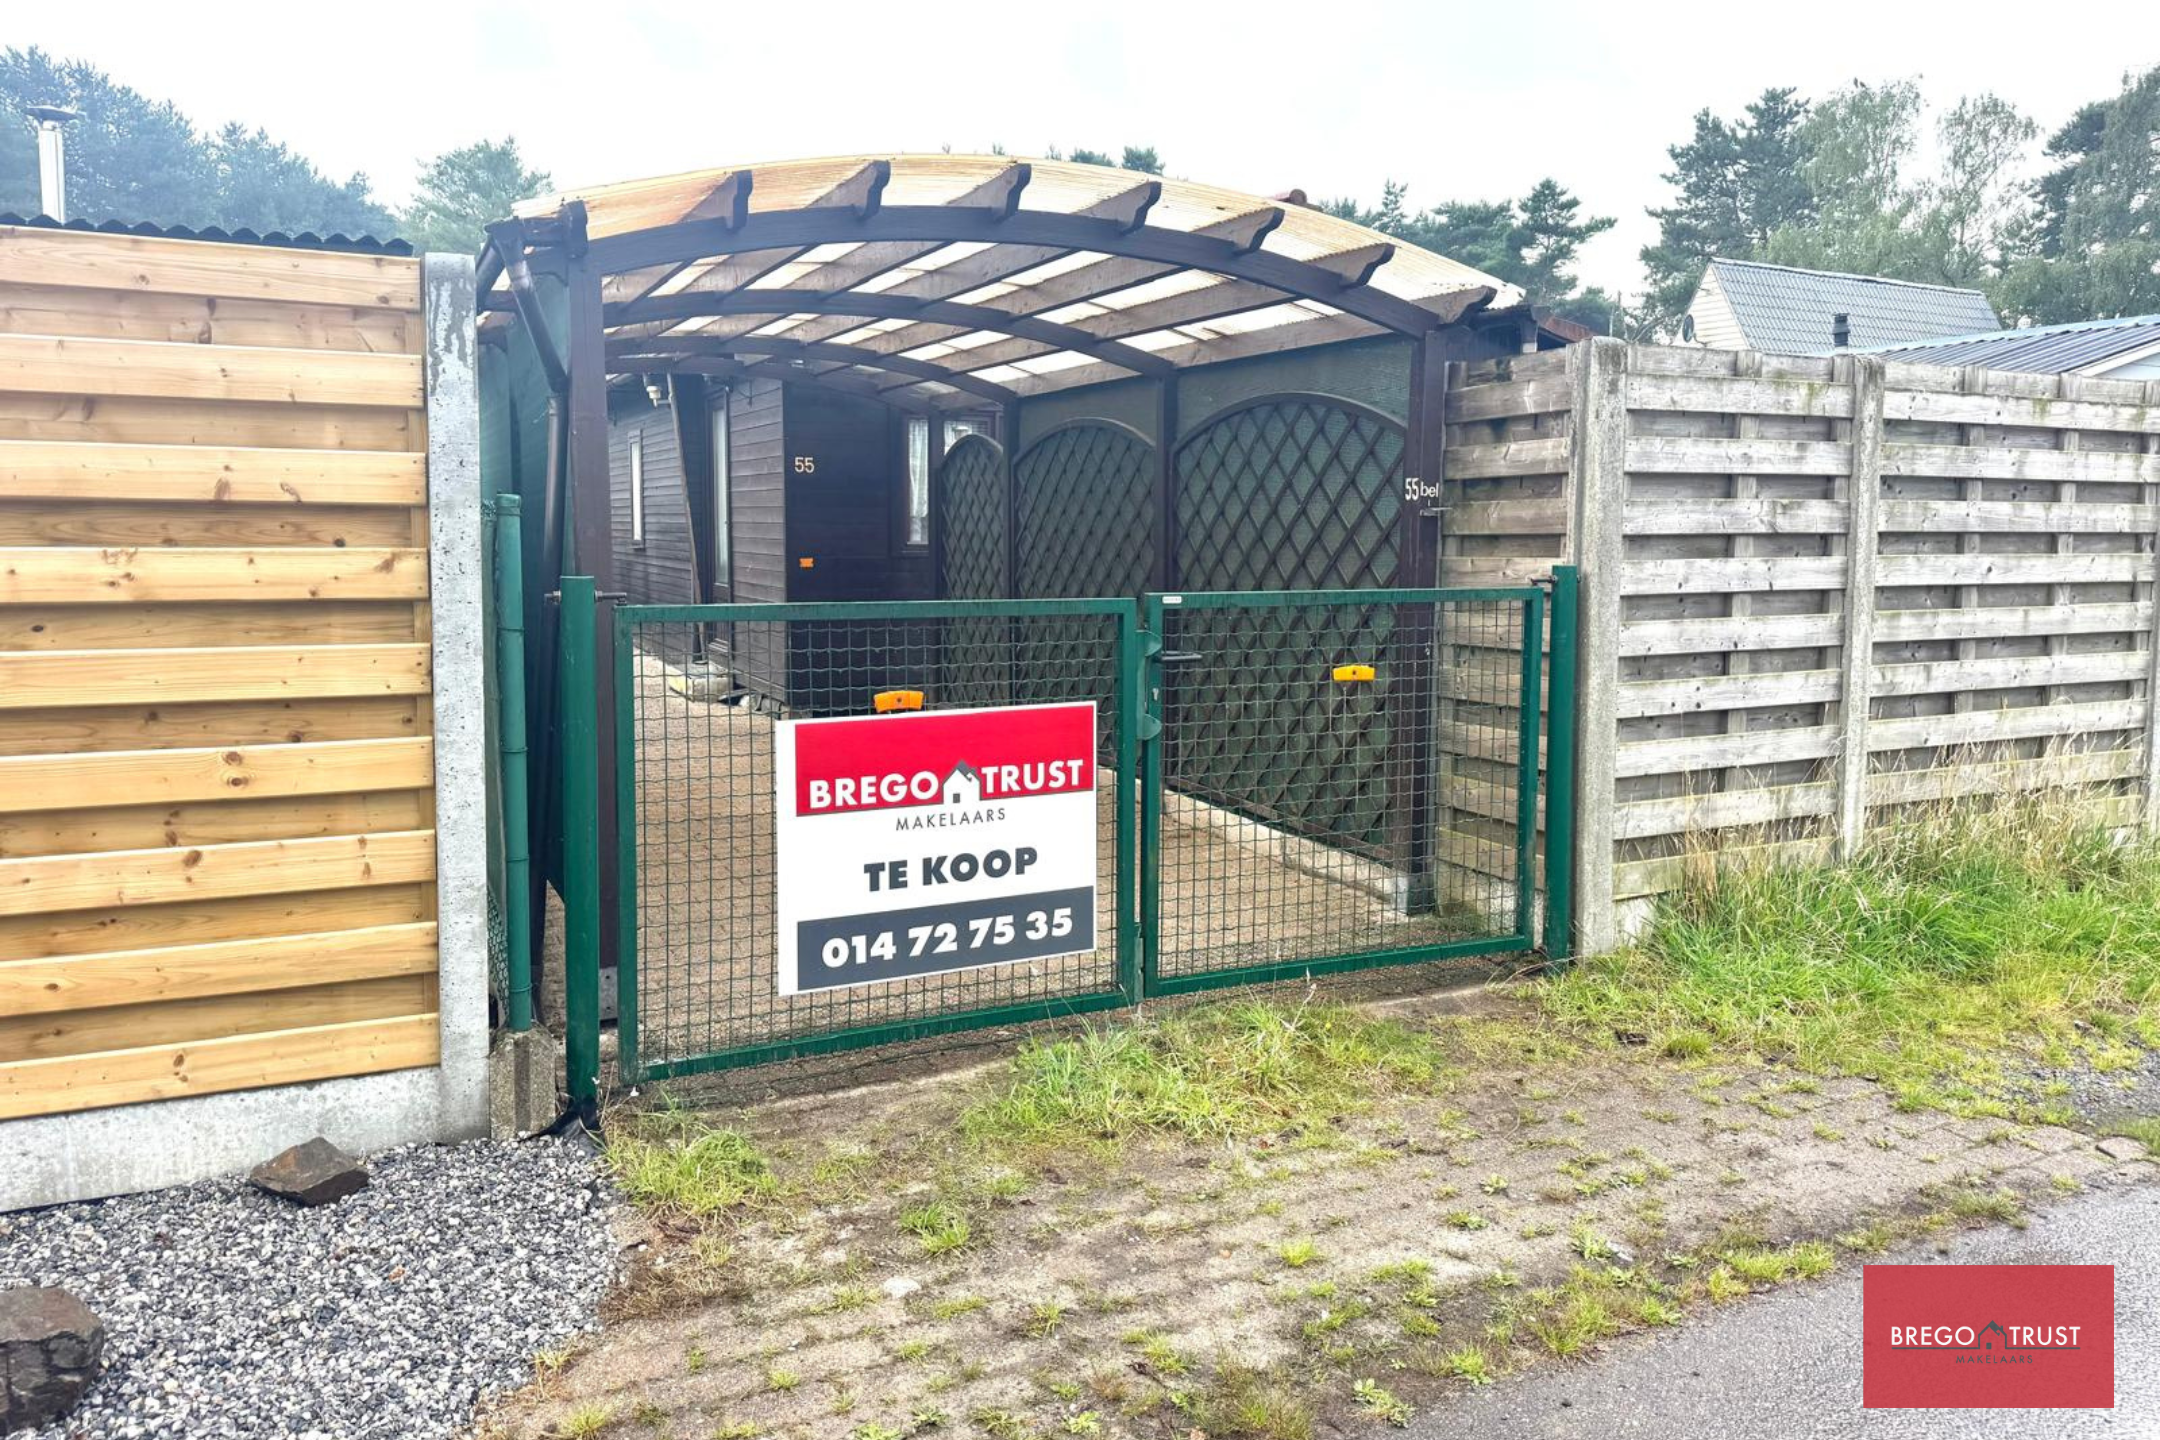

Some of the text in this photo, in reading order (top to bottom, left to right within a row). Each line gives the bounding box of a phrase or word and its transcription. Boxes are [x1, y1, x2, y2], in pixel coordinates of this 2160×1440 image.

[794, 456, 815, 473] 55
[809, 759, 1084, 809] BREGO TRUST
[895, 807, 1006, 831] MAKELAARS
[864, 846, 1038, 892] TE KOOP
[821, 907, 1073, 968] 014 72 75 35
